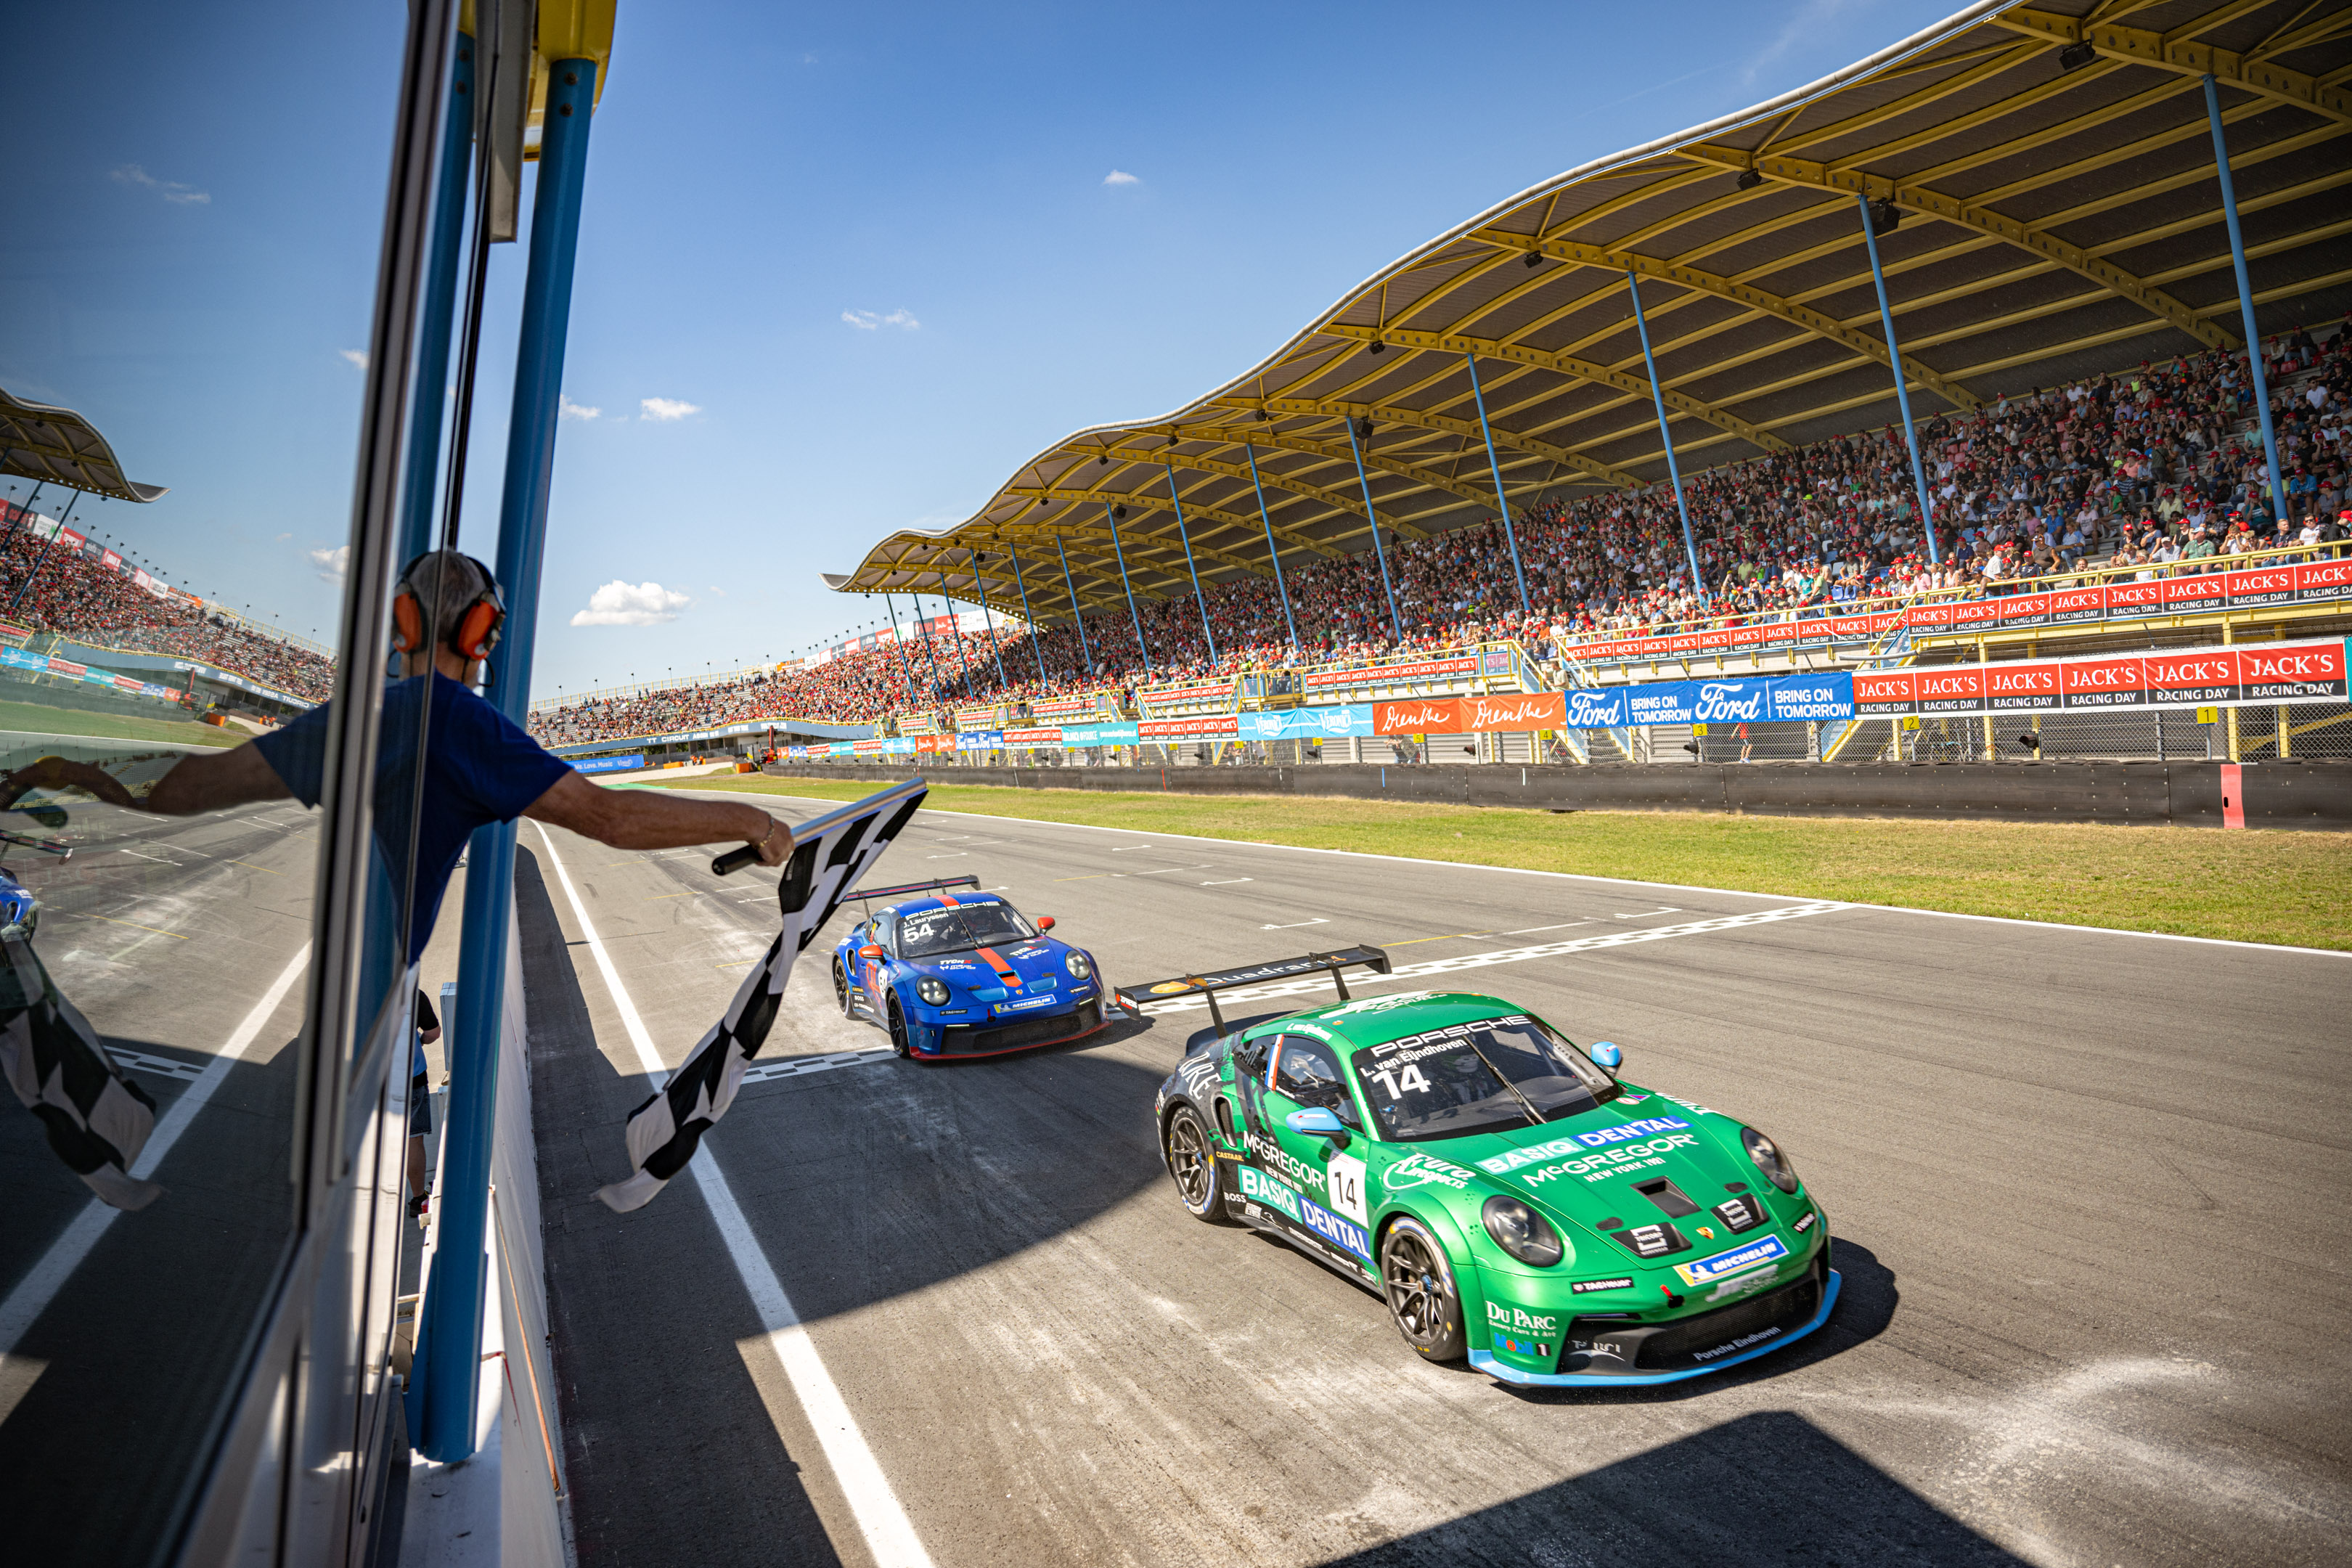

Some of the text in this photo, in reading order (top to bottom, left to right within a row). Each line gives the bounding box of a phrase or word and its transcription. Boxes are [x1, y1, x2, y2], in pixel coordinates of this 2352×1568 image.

[2303, 565, 2352, 584] JACK'
[2168, 581, 2220, 597] JACK'S
[2233, 574, 2288, 591] JACK'S
[2112, 587, 2156, 603] JACK'S
[2234, 592, 2288, 604] RACING DAY
[2303, 584, 2352, 598] RACING DA
[2004, 600, 2045, 614] JACK'S
[2056, 593, 2098, 608] JACK'S
[2169, 599, 2220, 611] RACING DAY
[1911, 610, 1948, 622] JACK'S
[1956, 605, 1995, 618] JACK'S
[2056, 611, 2083, 621] RACING
[2113, 605, 2156, 616] RACING DAY
[1836, 620, 1867, 632] JACK'S
[2005, 617, 2030, 626] RACING
[1734, 630, 1760, 642] JACK'S
[1766, 626, 1793, 638] JACK'S
[1801, 624, 1829, 634] JACK'S
[1643, 640, 1667, 650] JACK'S
[1673, 637, 1696, 648] JACK'S
[1702, 634, 1727, 645] JACK'S
[1590, 645, 1612, 655] JACK'S
[1616, 643, 1639, 653] JACK'S
[1439, 663, 1455, 671] JACK'S
[1458, 661, 1474, 669] JACK'S
[2155, 661, 2229, 682] JACK'S
[2251, 654, 2334, 677] JACK'S
[1993, 672, 2053, 690] JACK'S
[2070, 666, 2136, 687] JACK'S
[1859, 680, 1909, 697] JACK'S
[1923, 677, 1978, 694] JACK'S
[2253, 682, 2334, 696] RACING DAY
[1775, 688, 1833, 703] BRING ON
[2072, 693, 2136, 705] RACING DAY
[2157, 687, 2229, 701] RACING DAY
[1568, 692, 1620, 725] Ford
[1631, 695, 1678, 709] BRING ON
[1695, 683, 1760, 720] Ford
[1860, 703, 1909, 713] RACING DAY
[1924, 699, 1978, 711] RACING DAY
[1994, 696, 2053, 708] RACING DAY
[1632, 709, 1691, 722] TOMORROW
[1776, 703, 1852, 718] TOMORROW
[2204, 709, 2209, 722] 1
[1186, 722, 1201, 731] JACK'S
[1203, 722, 1219, 730] JACK'S
[1221, 720, 1237, 730] JACK'S
[1908, 717, 1914, 729] 2
[1698, 726, 1703, 735] 3
[905, 901, 1000, 920] PORSCHE
[910, 912, 949, 926] Lauryssen
[903, 923, 934, 942] 54
[1012, 997, 1051, 1008] MICHELIN
[1370, 1015, 1532, 1057] PORSCHE
[1360, 1038, 1469, 1077] L. van Eijndhoven
[1371, 1063, 1432, 1101] 14
[1479, 1116, 1690, 1173] BASIQ DENTAL
[1265, 1164, 1278, 1179] NEW
[1583, 1169, 1609, 1183] NEW
[1613, 1161, 1643, 1175] YORK
[1224, 1192, 1246, 1203] BOSS
[1334, 1172, 1357, 1210] 14
[1241, 1169, 1299, 1218] BASIQ
[1301, 1198, 1372, 1261] DENTAL
[1711, 1242, 1777, 1272] MICHELIN
[1512, 1326, 1530, 1336] Cars
[1494, 1332, 1534, 1355] Mobil
[1693, 1326, 1781, 1361] Porsche Eindhoven
